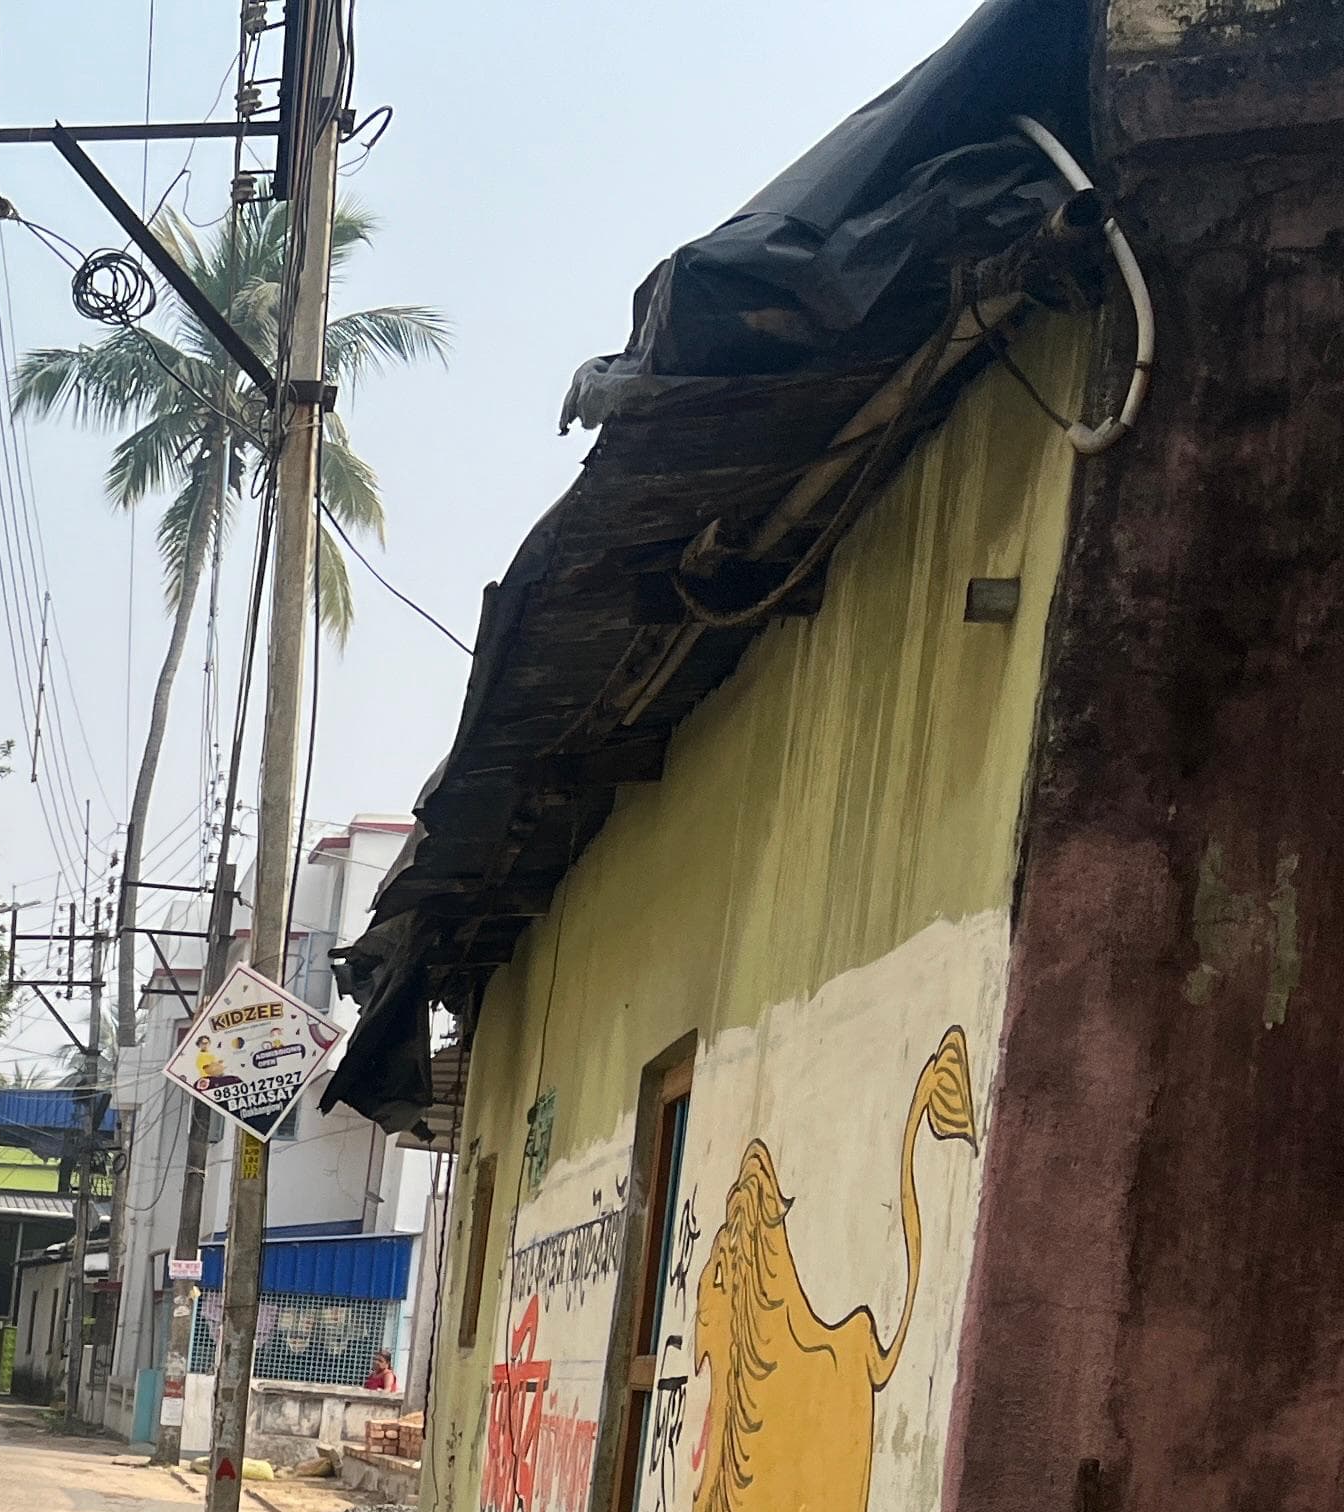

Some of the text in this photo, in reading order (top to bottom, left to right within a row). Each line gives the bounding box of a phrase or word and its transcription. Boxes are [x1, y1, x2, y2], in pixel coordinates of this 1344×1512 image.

[211, 1002, 283, 1032] KIDZEE
[257, 1059, 277, 1069] OPEN
[213, 1071, 302, 1101] 9830127927
[227, 1086, 294, 1112] BARASAT
